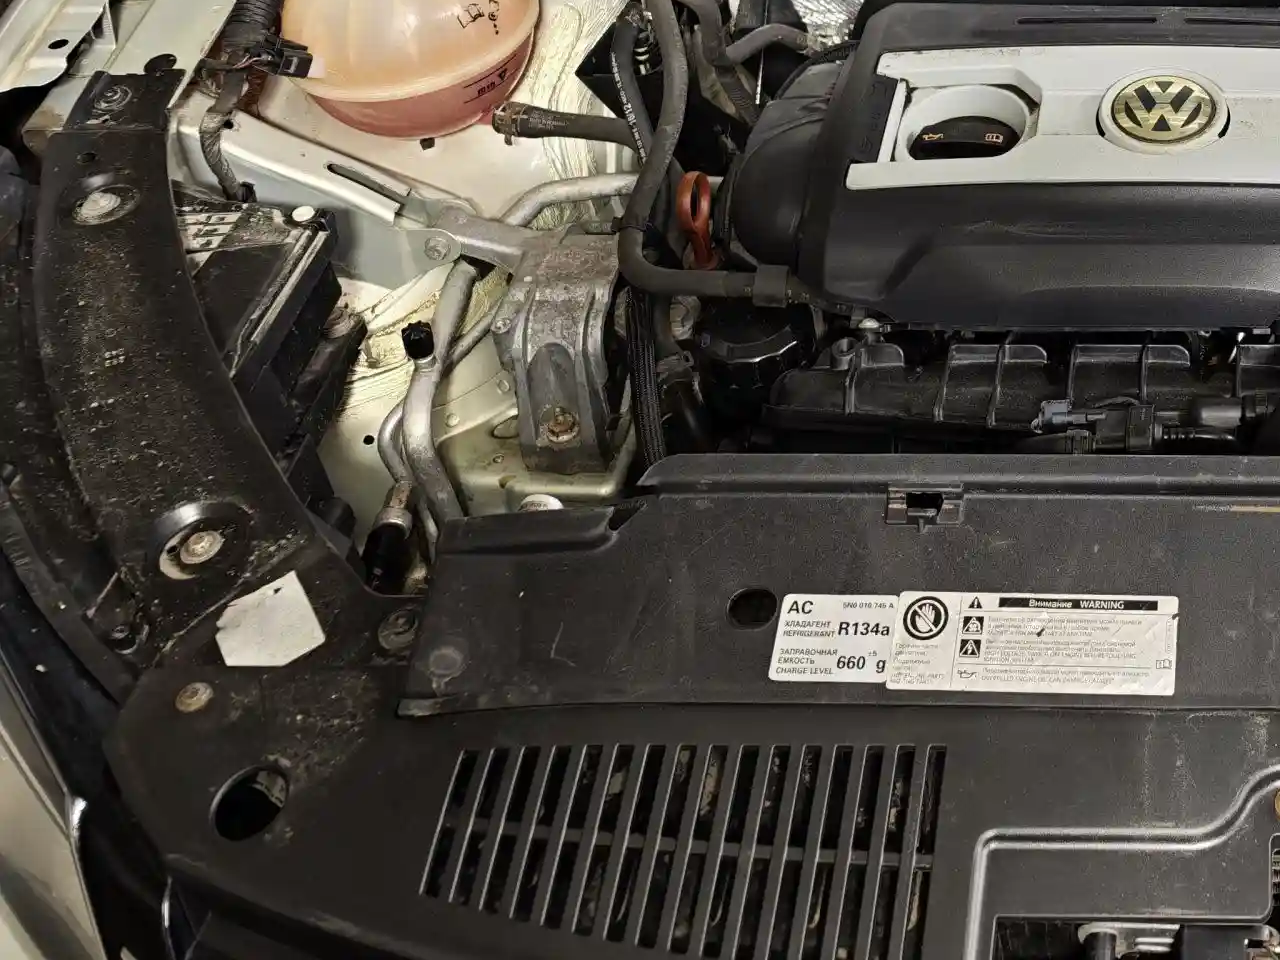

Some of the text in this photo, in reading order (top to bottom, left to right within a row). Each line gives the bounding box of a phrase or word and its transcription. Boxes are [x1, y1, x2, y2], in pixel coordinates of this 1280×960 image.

[787, 600, 814, 615] AC
[1028, 599, 1125, 610] Внимание WARNING
[784, 620, 832, 628] ХЛАДАГЕНТ
[838, 621, 890, 636] R134a
[782, 629, 836, 638] REFRIGERANT
[780, 648, 838, 656] ЗАПРАВОЧНАЯ
[837, 656, 866, 670] 660
[875, 659, 886, 674] g
[775, 666, 833, 675] CHARGE LEVEL
